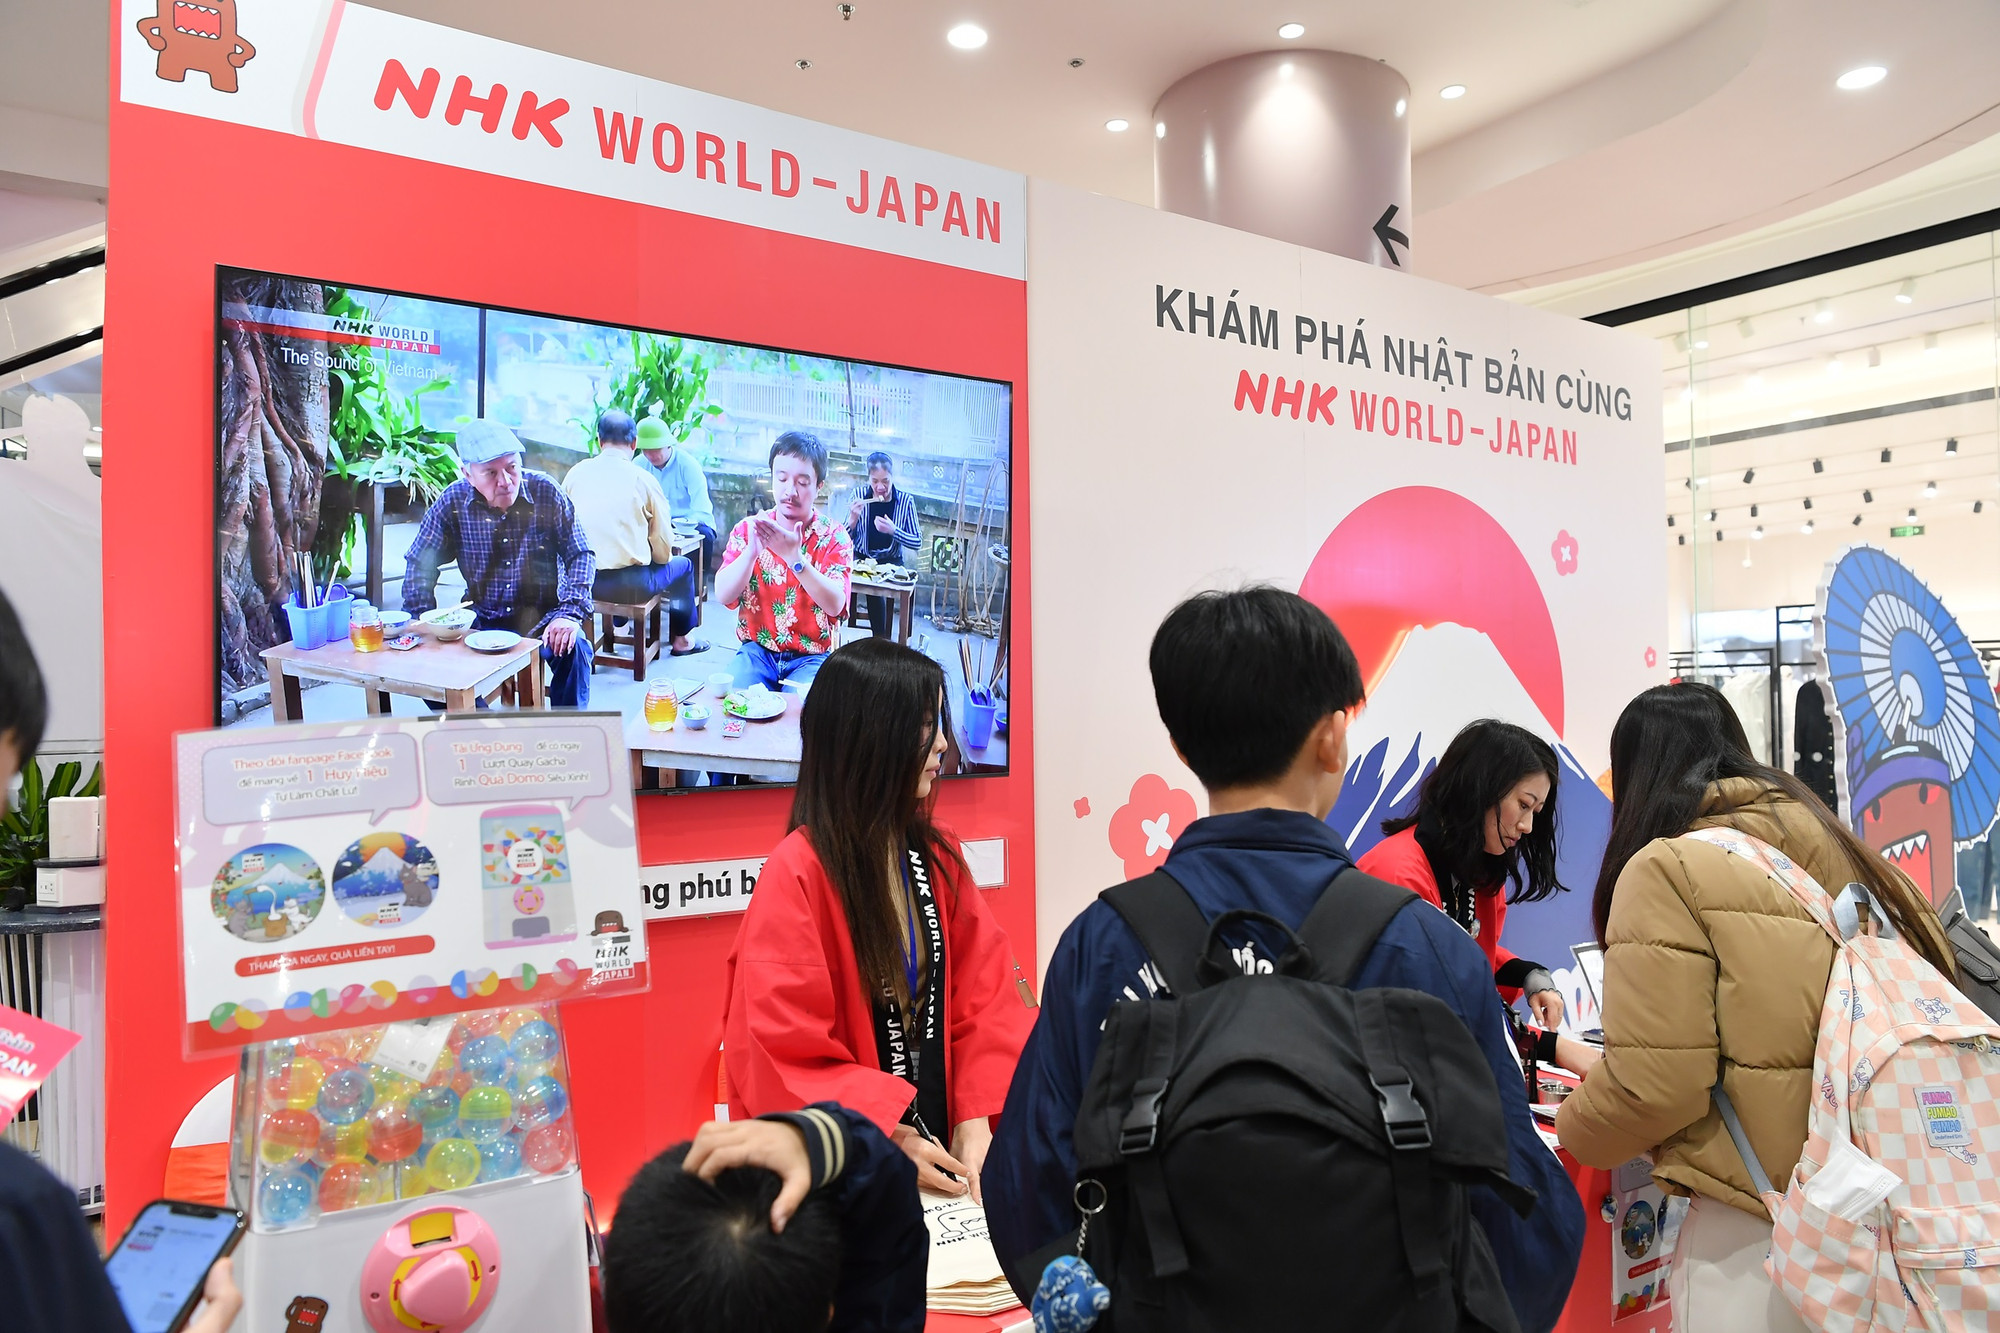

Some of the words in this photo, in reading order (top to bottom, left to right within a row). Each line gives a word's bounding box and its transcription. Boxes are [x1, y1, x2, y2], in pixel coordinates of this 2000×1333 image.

[374, 59, 570, 148] NHK
[593, 106, 1001, 243] WORLD-JAPAN
[333, 319, 374, 335] NHK
[379, 325, 429, 342] WORLD
[380, 340, 430, 353] JAPAN
[280, 347, 309, 366] The
[313, 352, 360, 372] Sound
[364, 358, 378, 373] of
[383, 359, 438, 379] Vietnam
[1156, 284, 1279, 350] KHÁM
[1296, 315, 1371, 369] PHÁ
[1384, 335, 1473, 392] NHẬT
[1485, 349, 1545, 404] BẢN
[1555, 371, 1632, 422] CÙNG
[1234, 369, 1338, 426] NHK
[1350, 390, 1578, 466] WORLD-JAPAN
[234, 759, 263, 769] Theo
[288, 752, 335, 767] fanpage
[338, 748, 392, 761] Faceook
[459, 759, 465, 770] 1
[508, 758, 534, 769] Quay
[536, 757, 566, 767] Gacha
[254, 777, 284, 787] mang
[307, 770, 313, 782] 1
[325, 768, 352, 782] Huy
[508, 773, 545, 784] Domo
[641, 883, 670, 910] ng
[680, 871, 731, 907] phú
[908, 850, 931, 898] NHK
[924, 903, 941, 963] WORLD
[926, 984, 936, 1039] JAPAN
[0, 1050, 37, 1077] PAN
[887, 1019, 906, 1076] JAPAN
